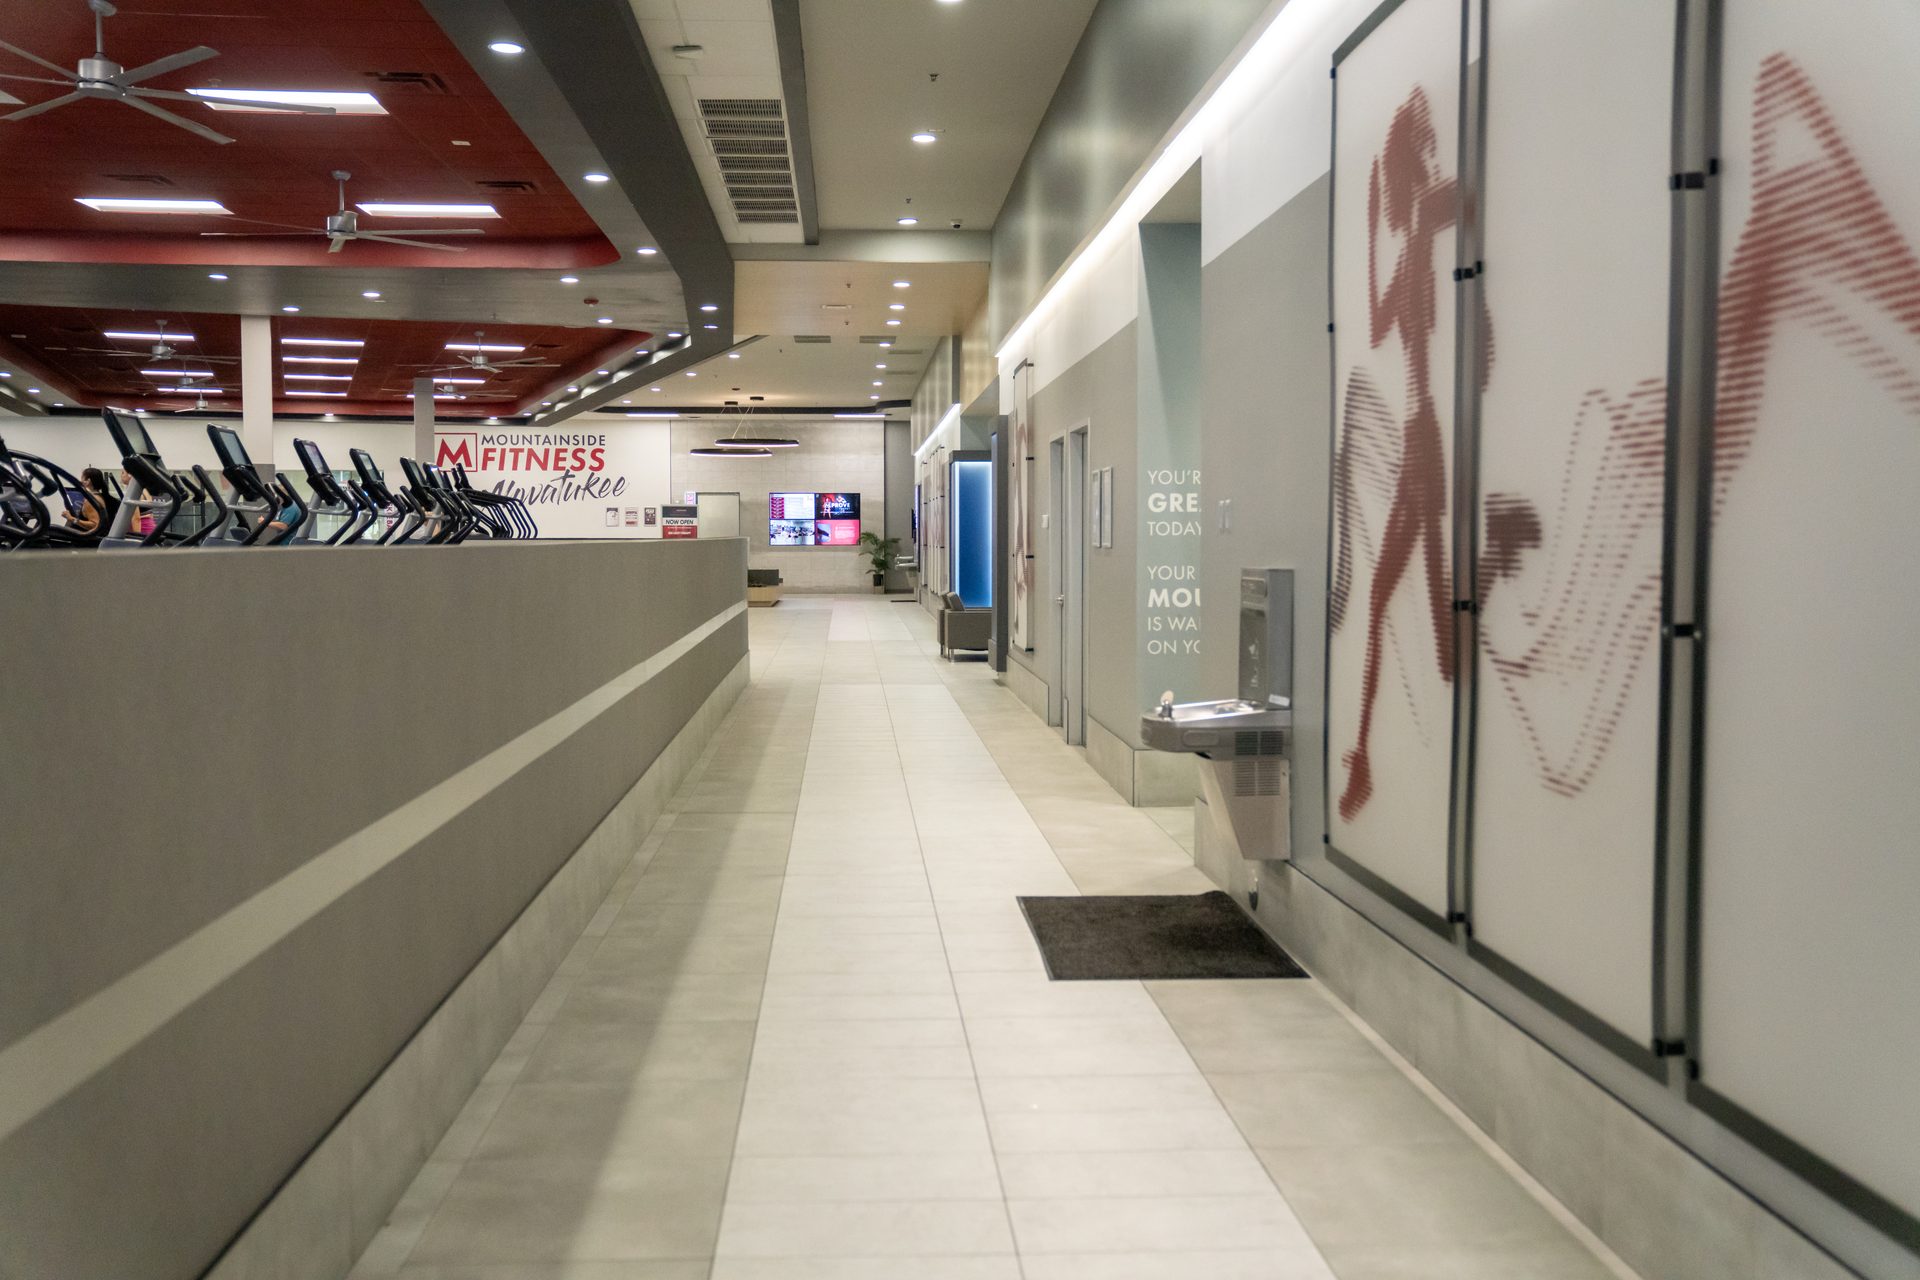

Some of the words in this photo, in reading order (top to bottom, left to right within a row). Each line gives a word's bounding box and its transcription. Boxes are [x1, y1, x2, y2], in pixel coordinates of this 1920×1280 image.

[481, 434, 606, 446] MOUNTAINSIDE
[436, 438, 473, 468] M
[481, 447, 606, 472] FITNESS
[1147, 492, 1202, 513] GRE
[1146, 521, 1202, 536] TODAY
[1147, 565, 1196, 580] YOUR
[1147, 616, 1162, 632] IS
[1167, 616, 1201, 631] WA
[1147, 640, 1177, 655] ON
